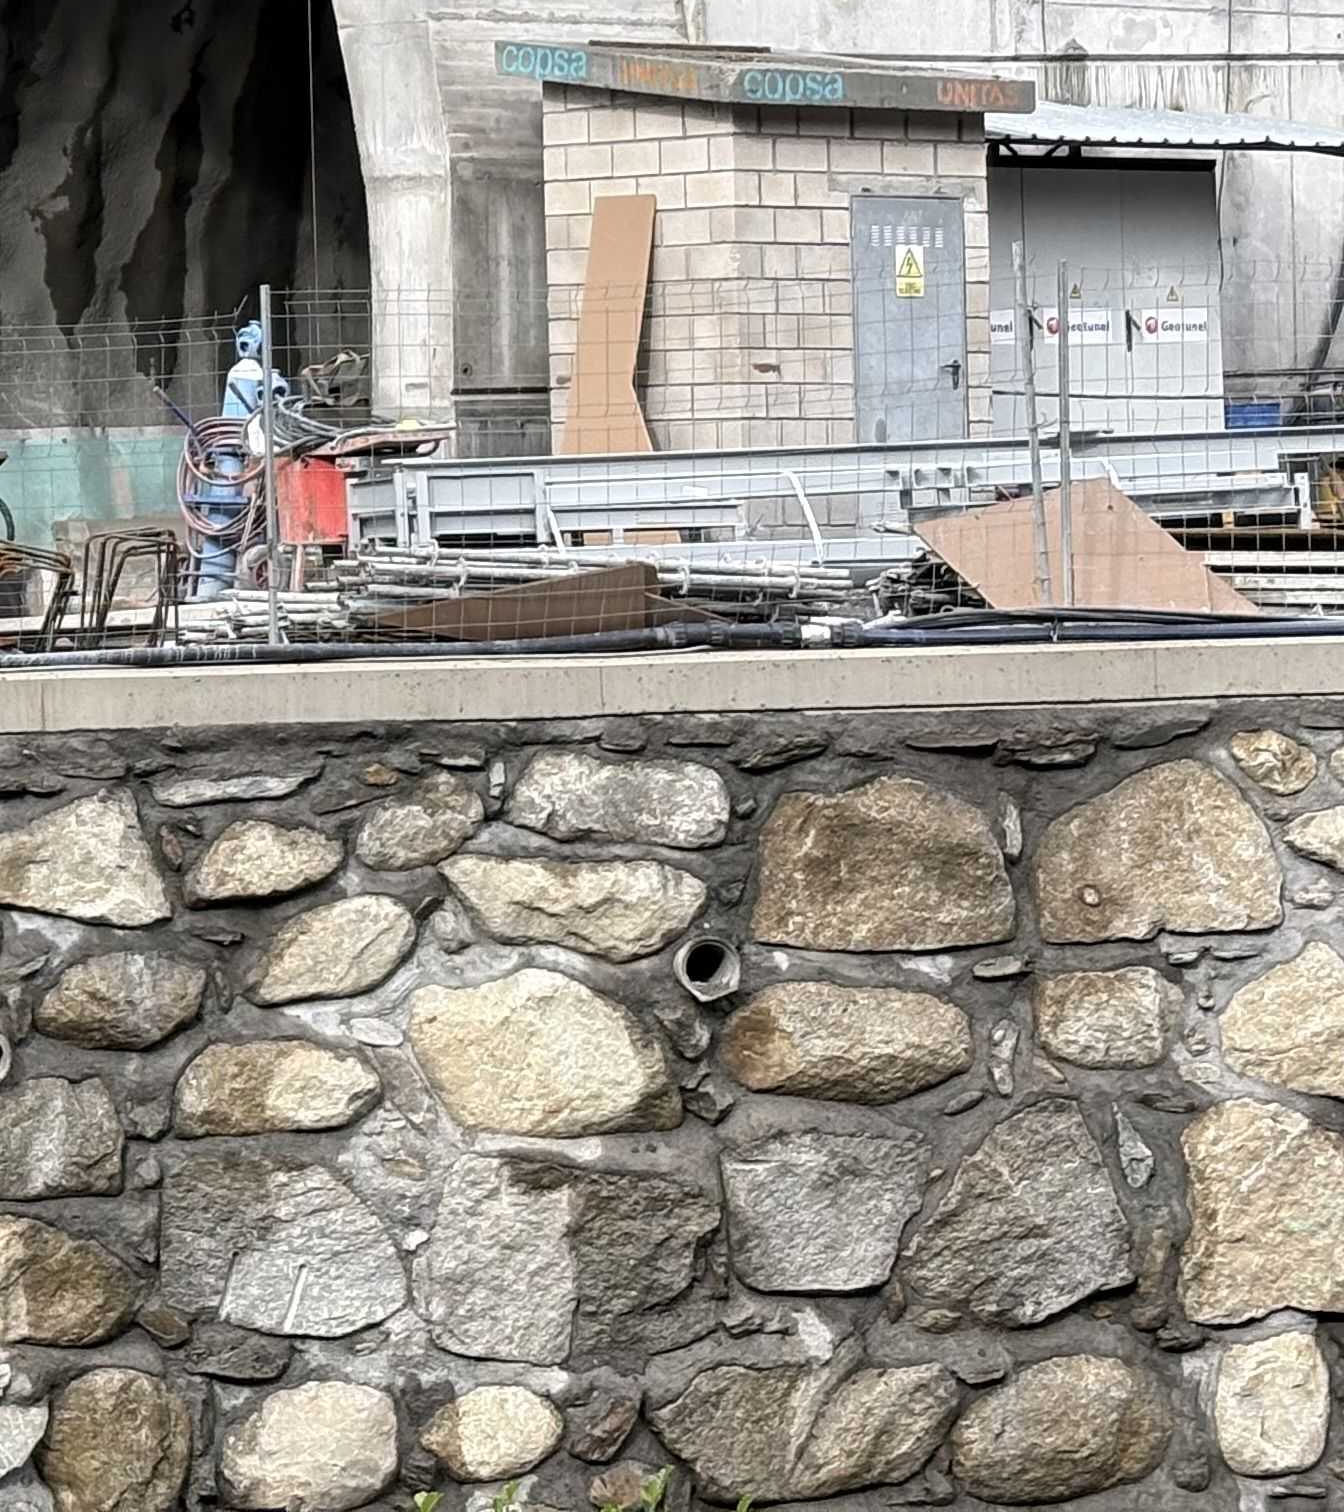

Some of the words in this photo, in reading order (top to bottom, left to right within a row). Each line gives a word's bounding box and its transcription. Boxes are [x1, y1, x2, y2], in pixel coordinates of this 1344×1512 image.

[501, 45, 588, 79] copsa
[743, 70, 845, 102] copsa
[990, 321, 1013, 333] unel
[1068, 320, 1110, 332] eotunel
